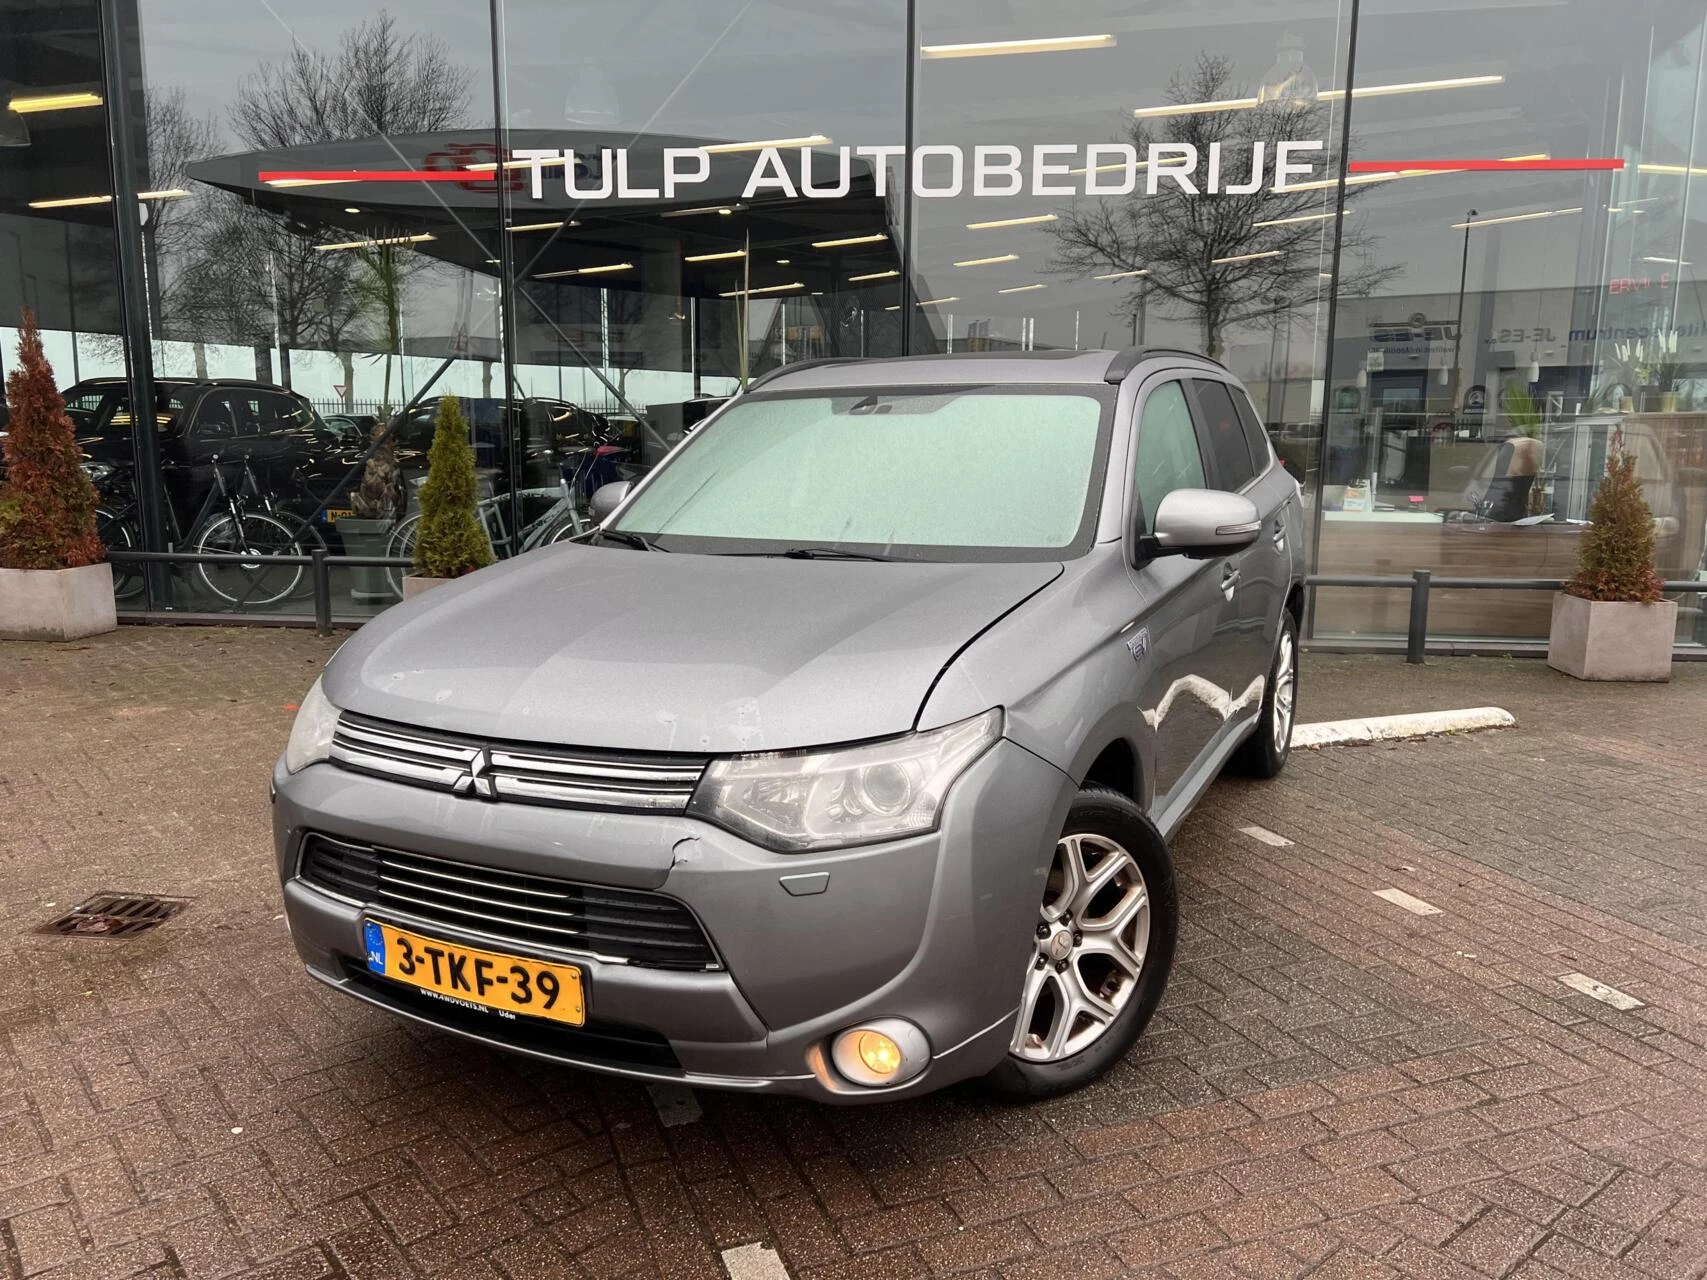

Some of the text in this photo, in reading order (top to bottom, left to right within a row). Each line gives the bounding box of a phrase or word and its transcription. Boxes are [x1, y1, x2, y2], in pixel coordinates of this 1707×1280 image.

[512, 146, 711, 199] TULP
[741, 140, 1325, 198] AUTOBEDRIJF
[369, 951, 384, 966] NL
[396, 937, 560, 1010] 3-TKF-39
